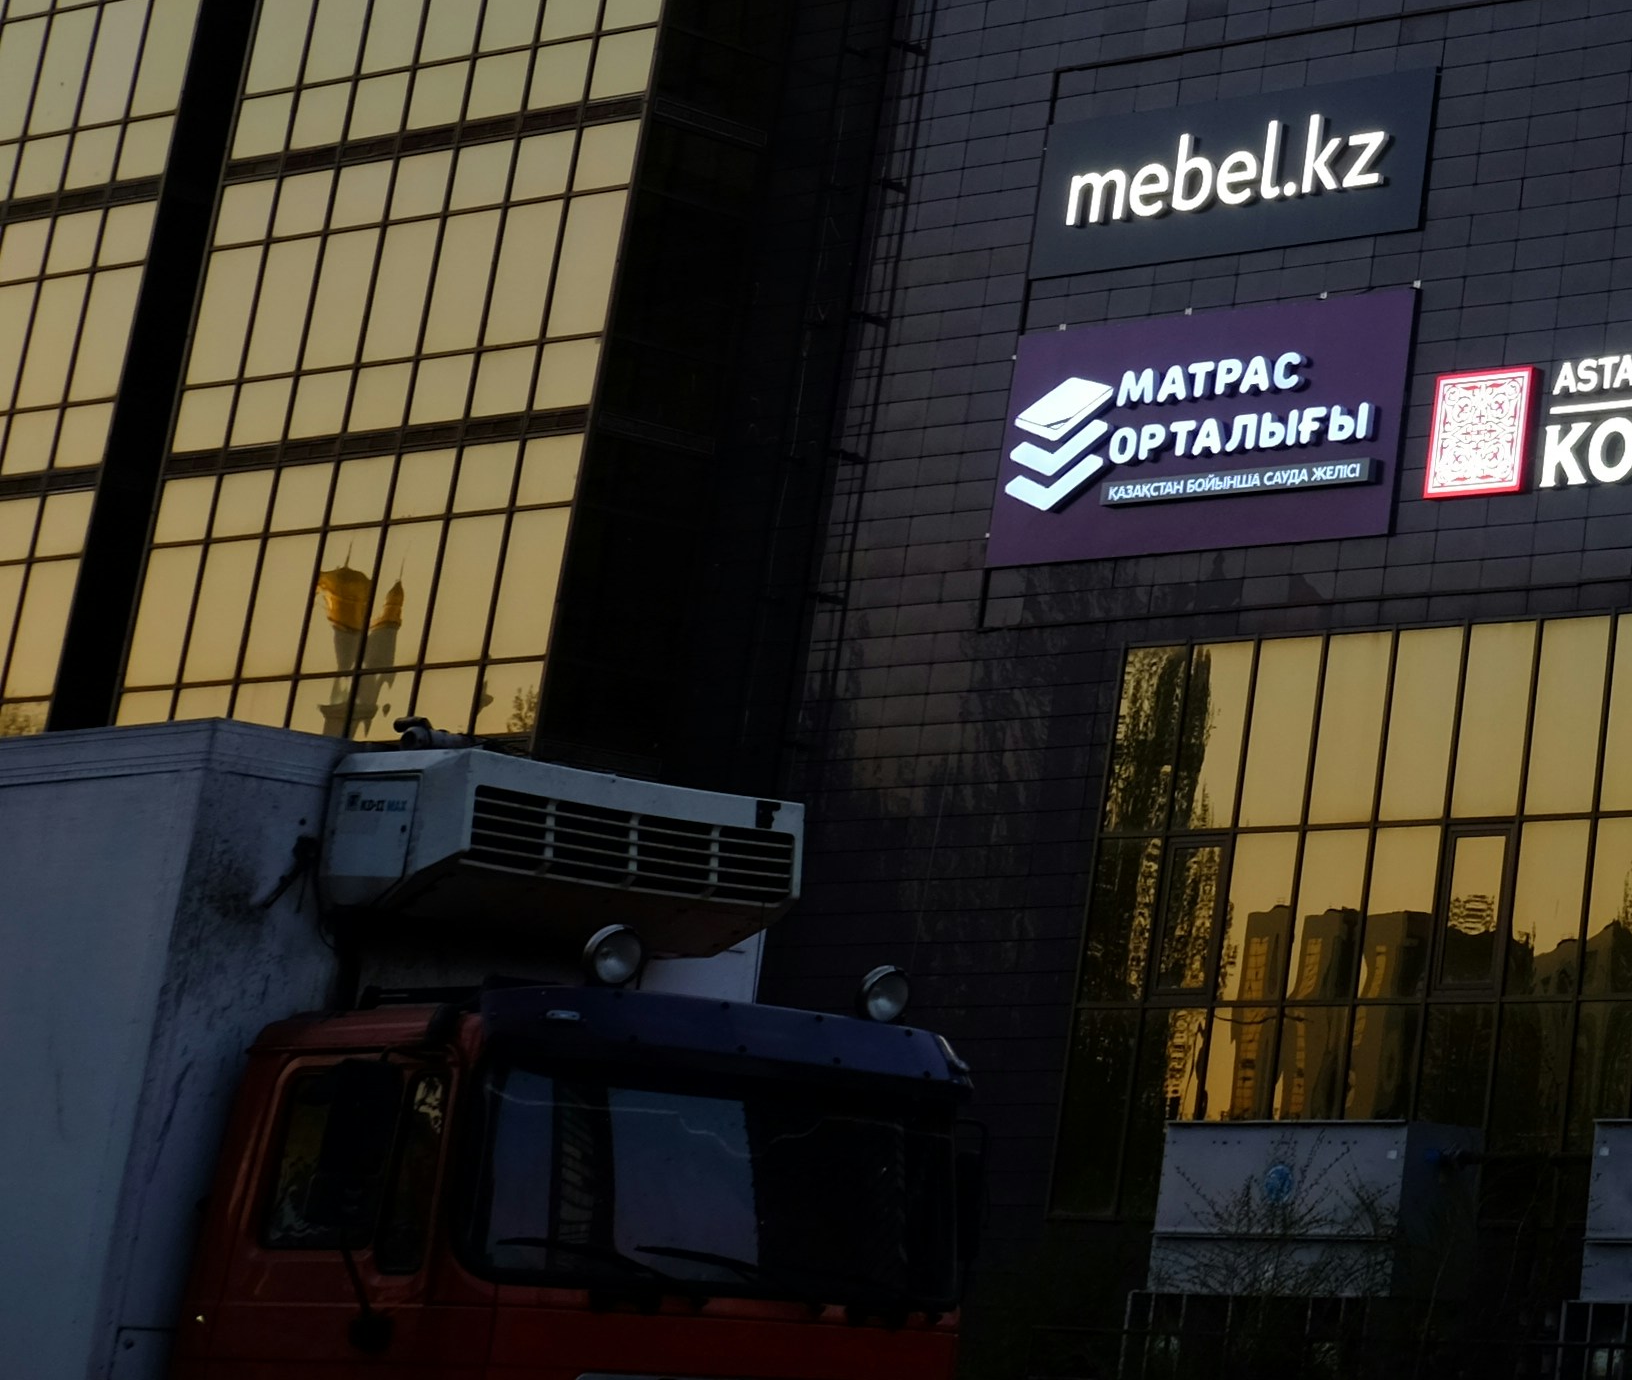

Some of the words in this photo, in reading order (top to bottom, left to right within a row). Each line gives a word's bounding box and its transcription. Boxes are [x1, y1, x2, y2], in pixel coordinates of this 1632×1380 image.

[1065, 113, 1391, 226] mebel.kz
[1113, 351, 1305, 408] МАТРАС
[1108, 402, 1372, 466] ОРТАЛЫҒЫ
[1186, 473, 1261, 493] БОЙЫНША
[1263, 468, 1308, 486] САУДА
[1311, 463, 1360, 481] ЖЕЛІСІ
